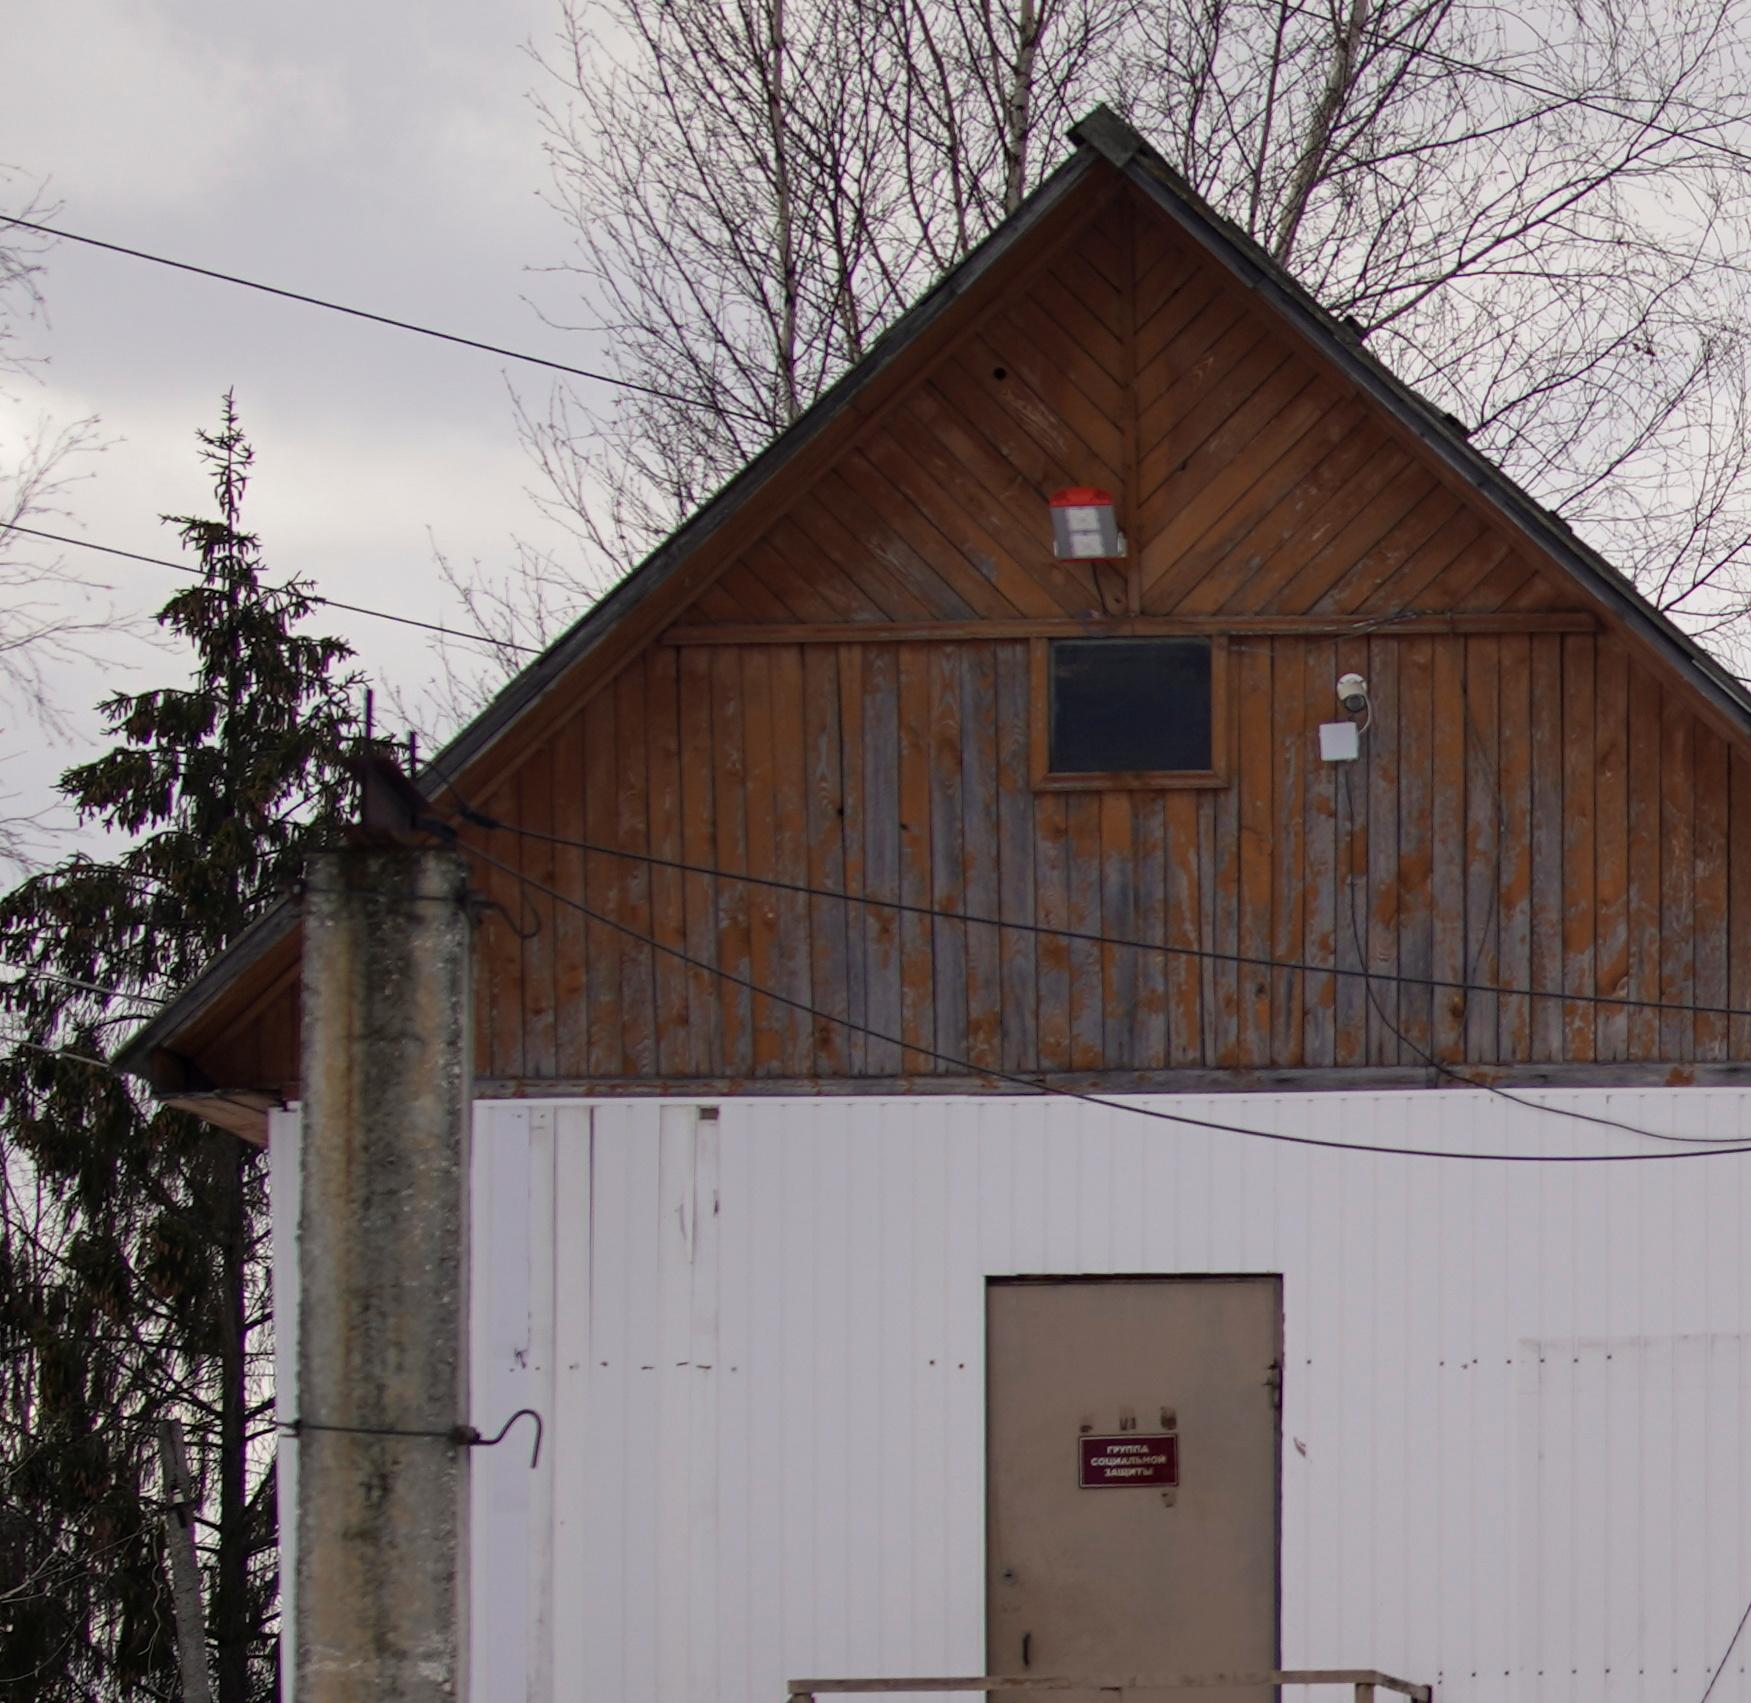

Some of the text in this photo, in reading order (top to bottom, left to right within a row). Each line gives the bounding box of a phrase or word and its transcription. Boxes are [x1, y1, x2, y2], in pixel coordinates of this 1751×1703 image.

[1106, 1445, 1149, 1455] ГРУППА
[1090, 1455, 1167, 1467] СОЦИАЛЬНОЙ
[1104, 1467, 1153, 1477] ЗАЩИТЫ
